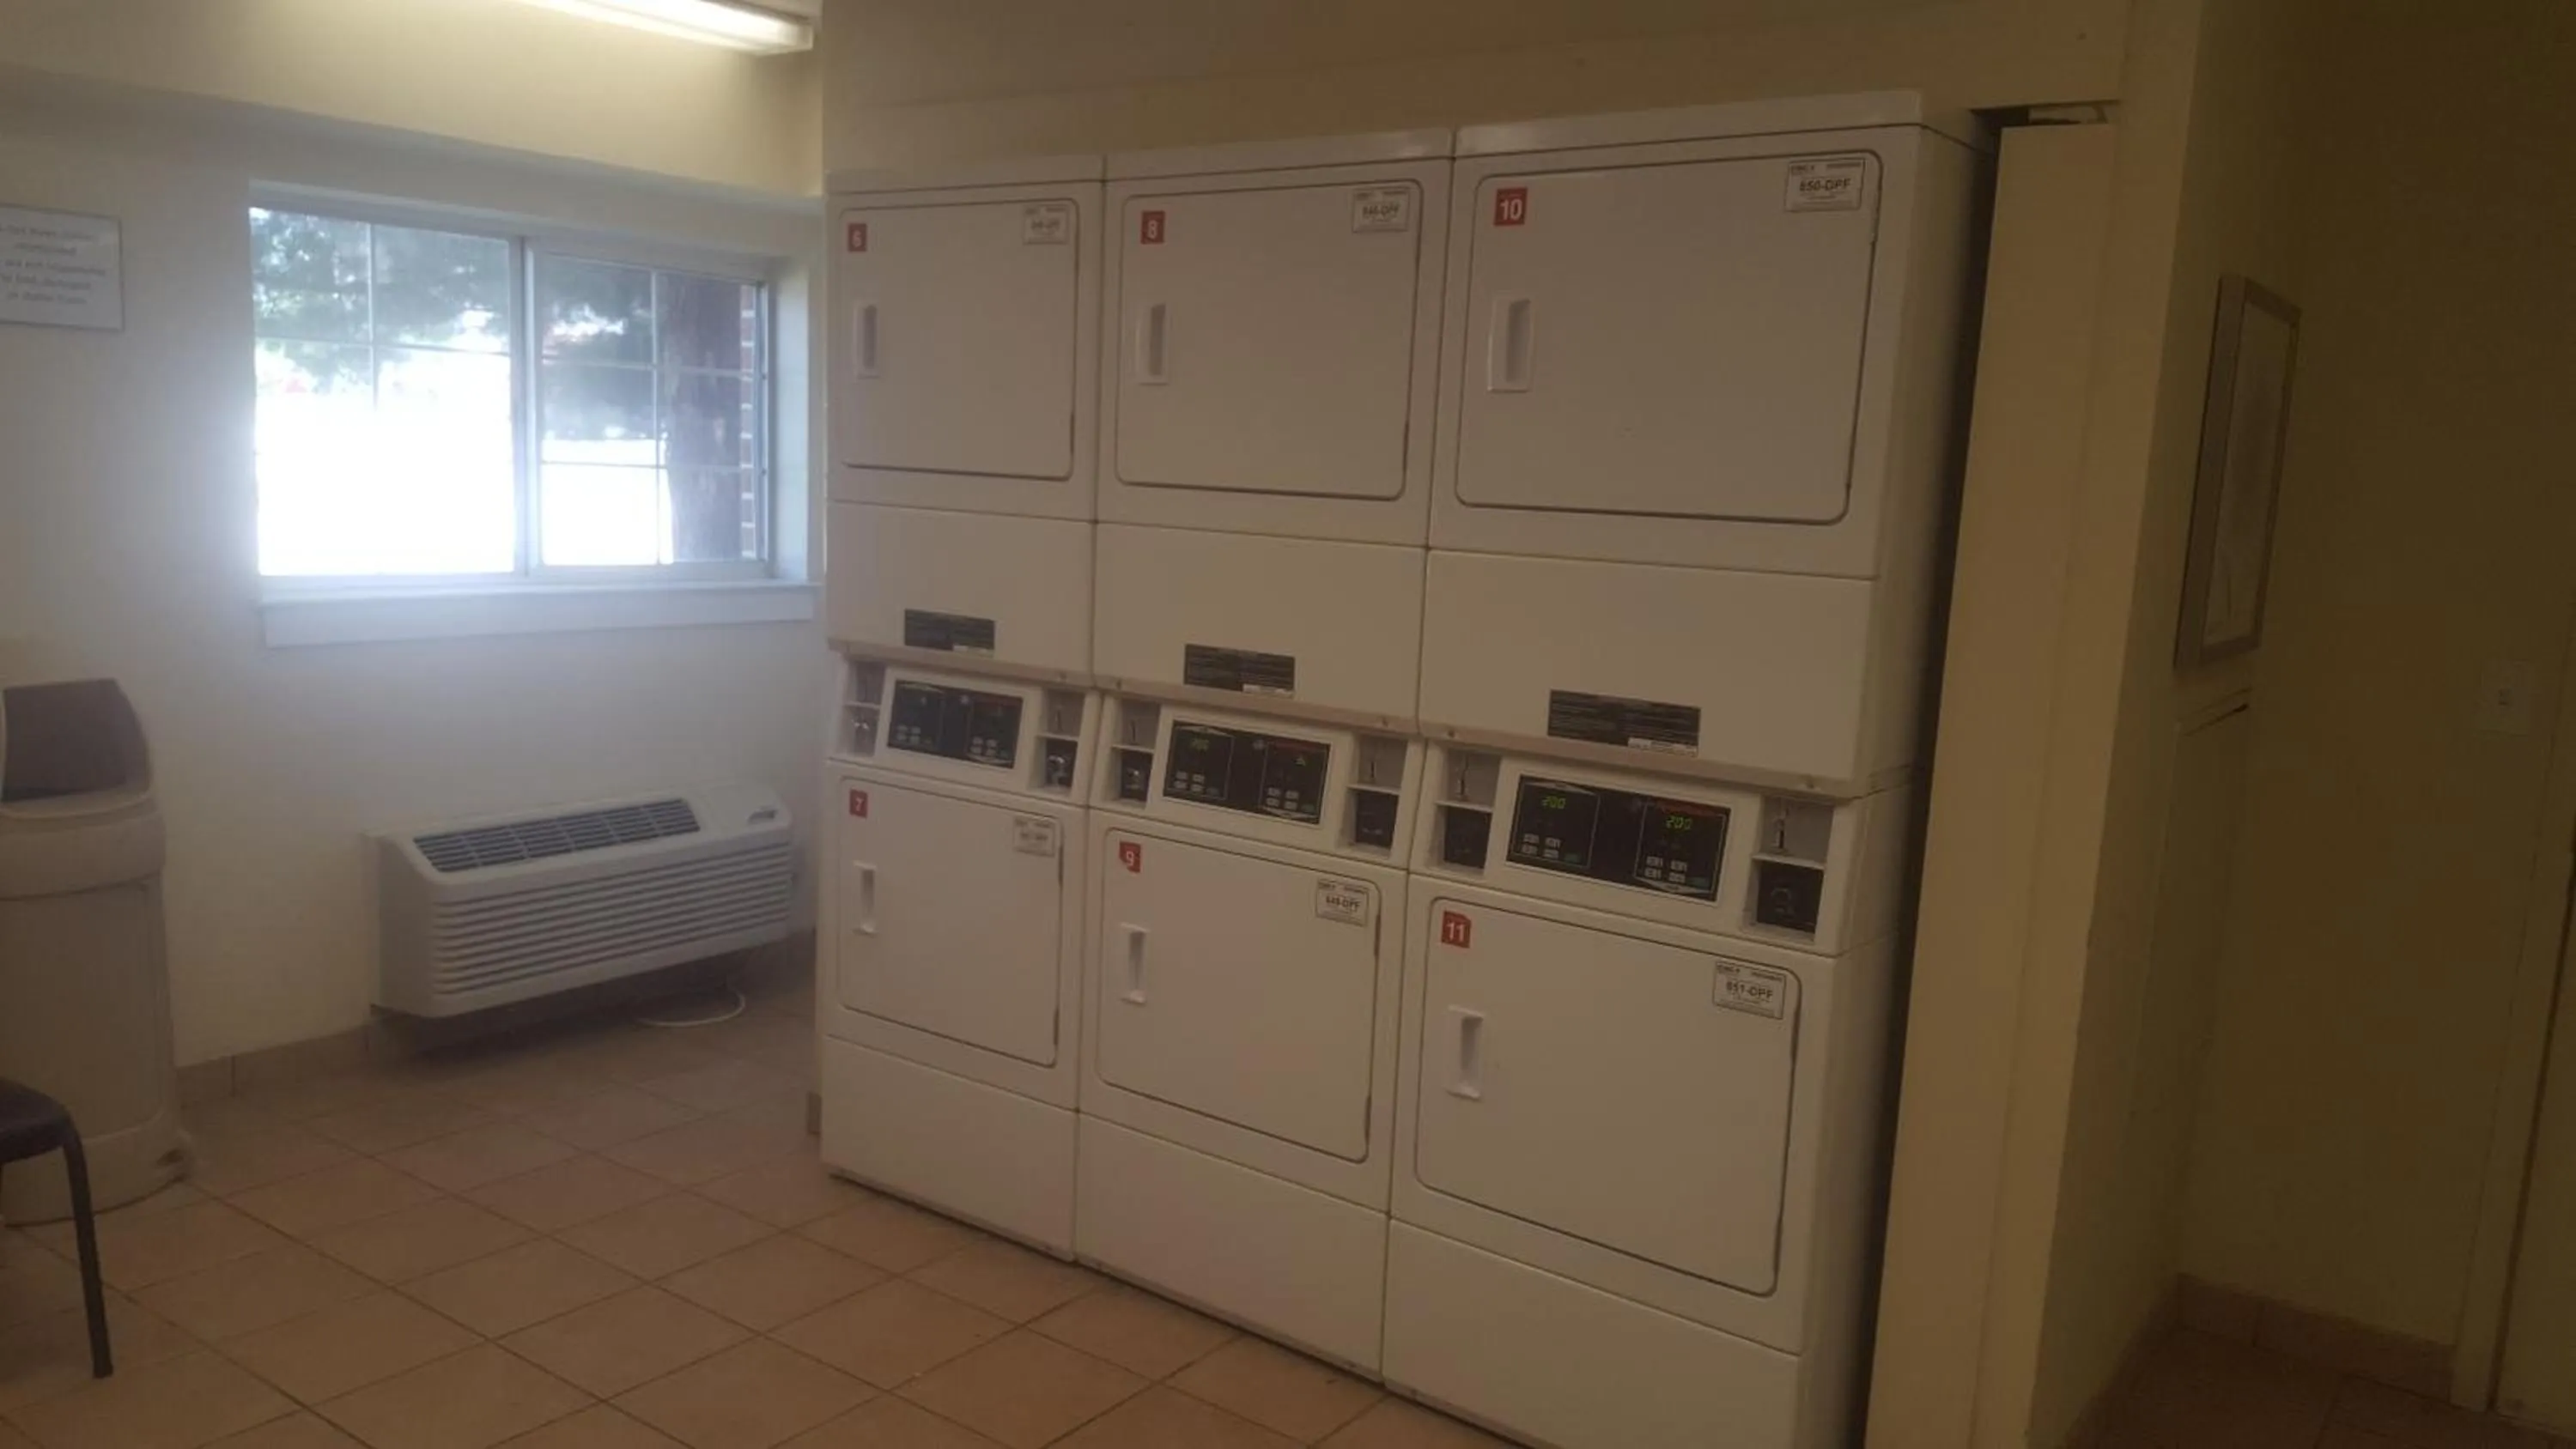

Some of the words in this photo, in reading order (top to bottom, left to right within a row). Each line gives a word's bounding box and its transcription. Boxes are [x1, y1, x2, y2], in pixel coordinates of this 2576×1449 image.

[1499, 198, 1522, 221] 10
[852, 229, 862, 248] 6
[1148, 220, 1158, 239] 8
[855, 797, 864, 812] 7
[1126, 851, 1134, 866] 9
[1446, 921, 1465, 942] 11
